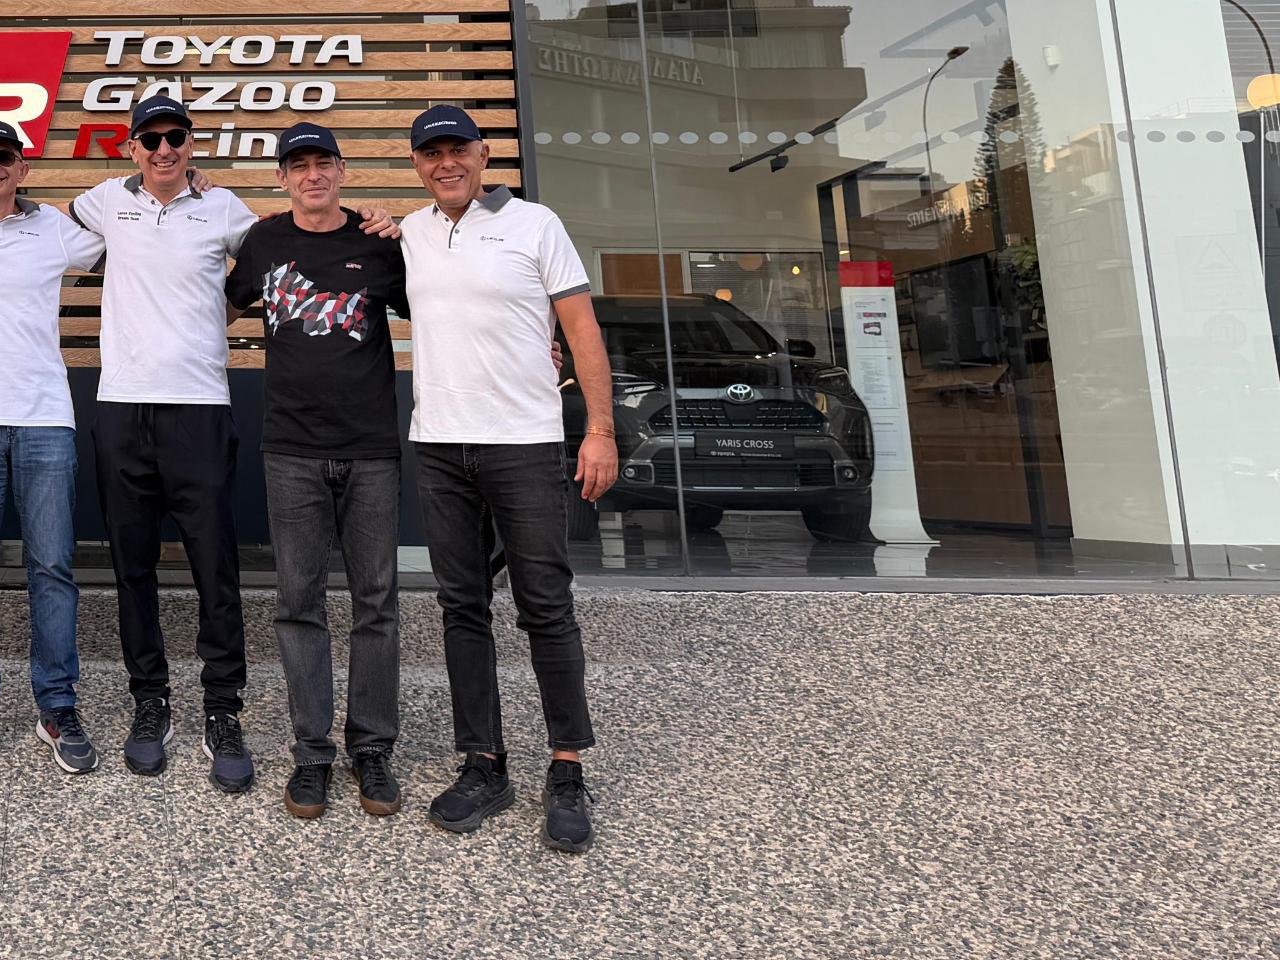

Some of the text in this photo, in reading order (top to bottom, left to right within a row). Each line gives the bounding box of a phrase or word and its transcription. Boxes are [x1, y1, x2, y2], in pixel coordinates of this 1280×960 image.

[94, 30, 363, 65] TOYOTA
[716, 439, 774, 449] YARIS CROSS
